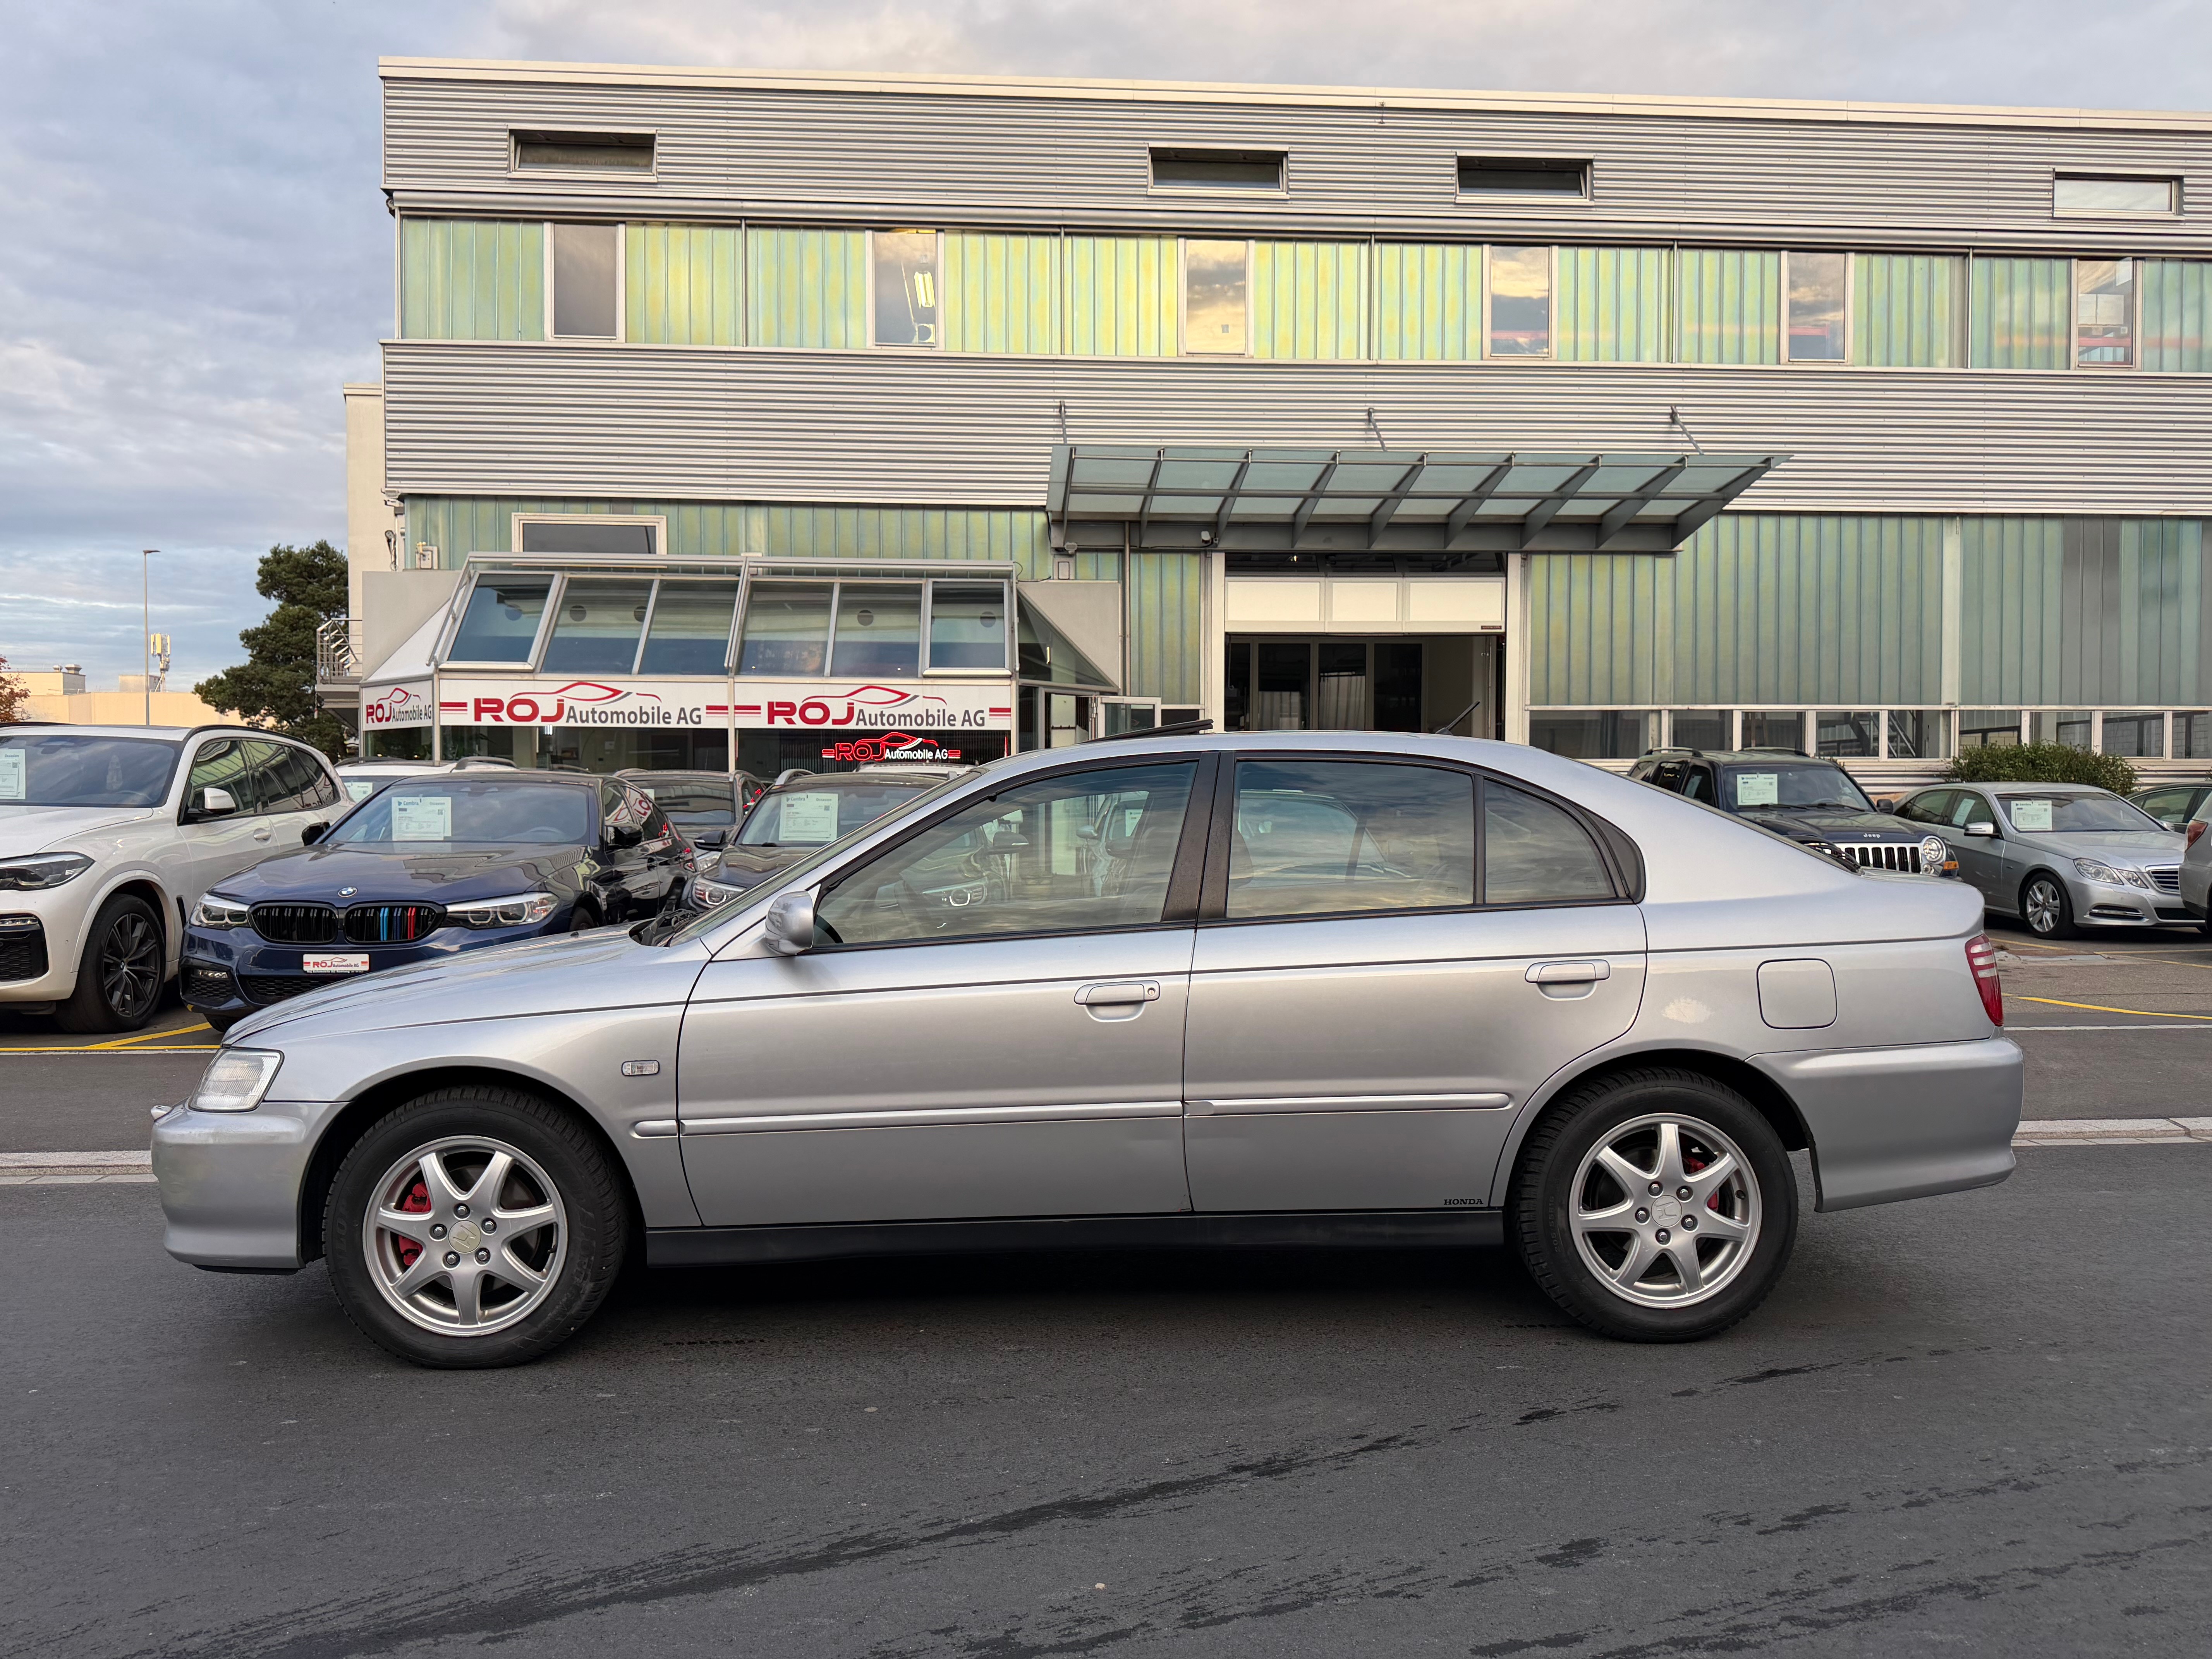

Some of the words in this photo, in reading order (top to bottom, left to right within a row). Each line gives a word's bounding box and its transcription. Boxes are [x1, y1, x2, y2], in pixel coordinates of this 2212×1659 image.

[366, 702, 392, 724] ROJ
[392, 704, 422, 722] Automobile
[424, 704, 432, 720] AG
[474, 698, 564, 722] ROJ
[566, 706, 672, 724] Automobile
[677, 707, 702, 725] AG
[768, 701, 854, 725] ROJ
[855, 709, 956, 726] Automobile
[961, 709, 985, 726] AG
[835, 743, 886, 761] ROJ
[885, 749, 933, 759] Automobile
[935, 749, 948, 759] AG
